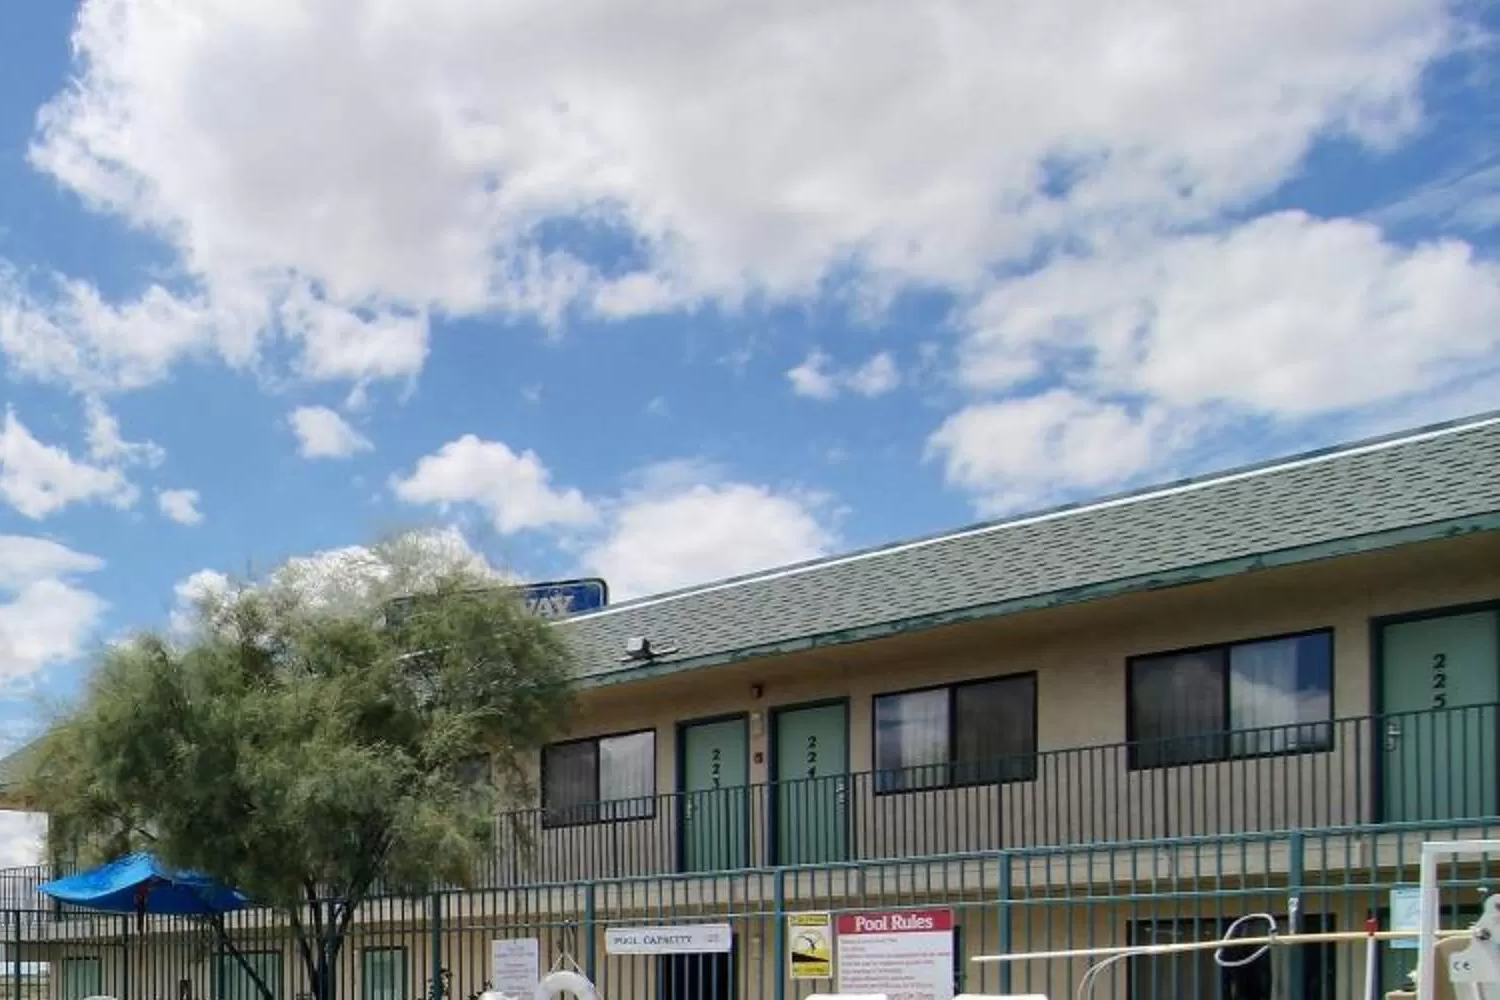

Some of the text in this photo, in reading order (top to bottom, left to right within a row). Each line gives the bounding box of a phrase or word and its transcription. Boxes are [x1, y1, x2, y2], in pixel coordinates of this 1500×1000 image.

[1432, 653, 1446, 709] 225
[855, 914, 933, 932] Pool Rules
[643, 934, 692, 945] CAPACITY
